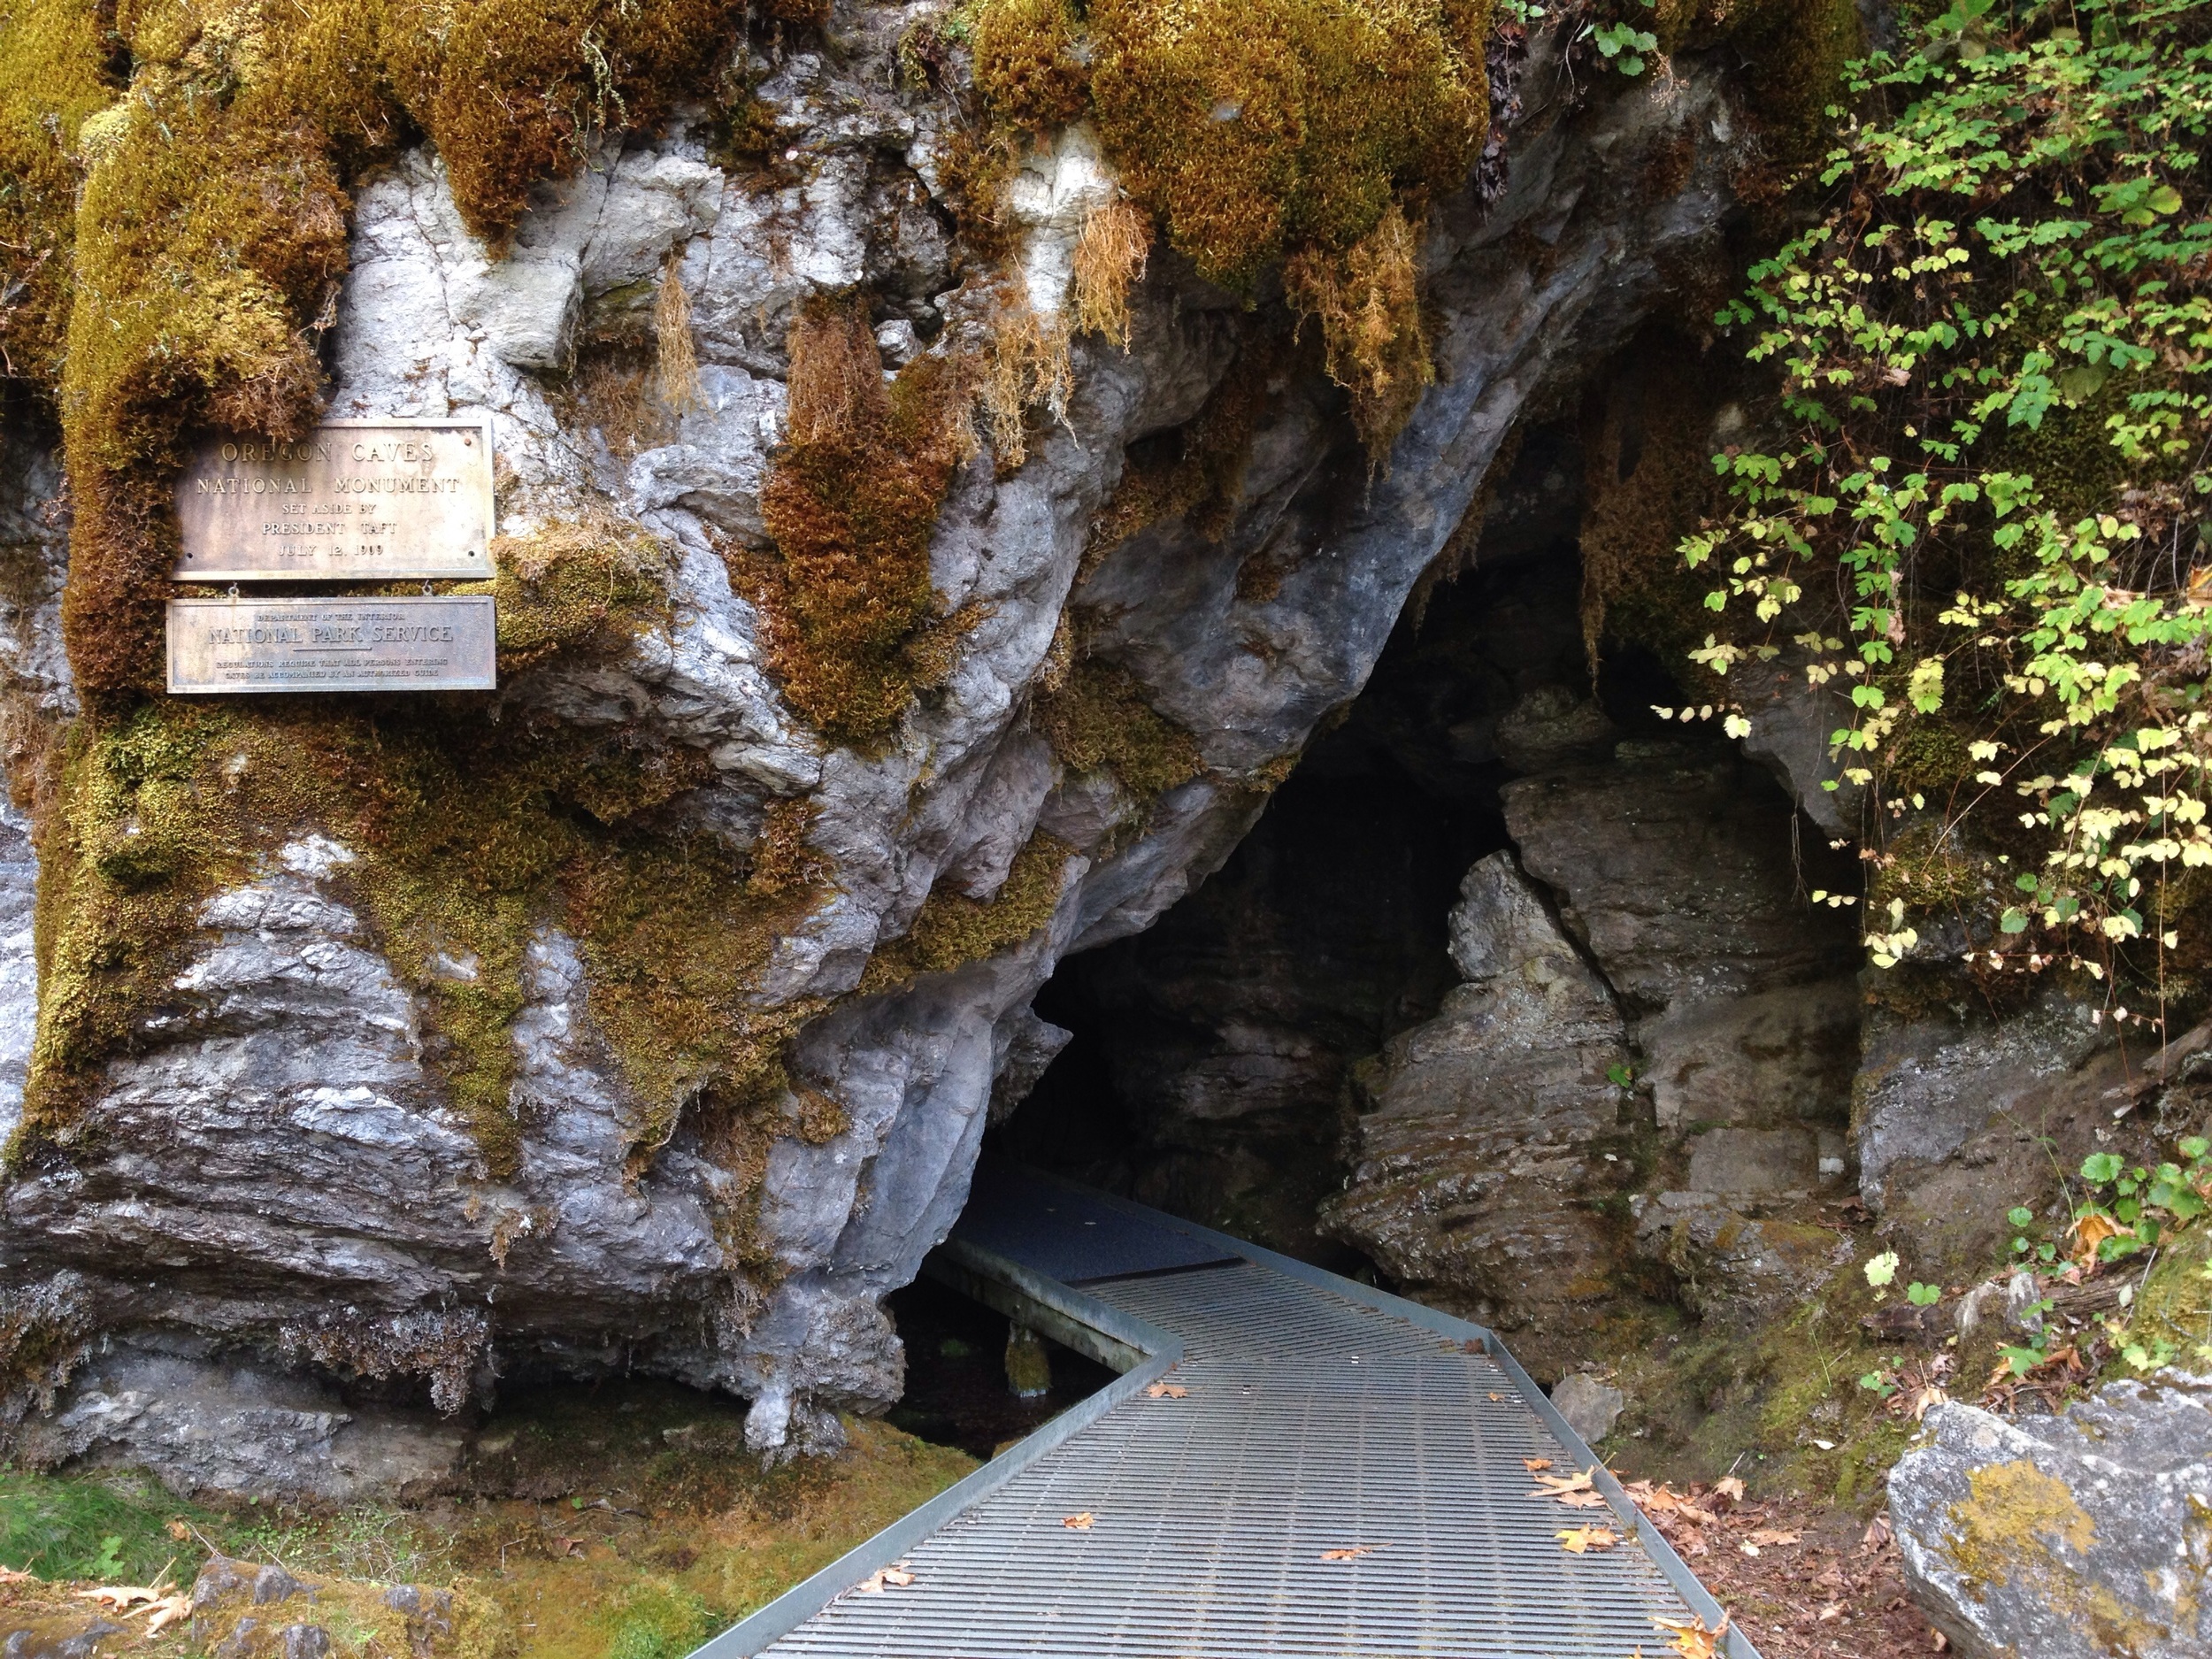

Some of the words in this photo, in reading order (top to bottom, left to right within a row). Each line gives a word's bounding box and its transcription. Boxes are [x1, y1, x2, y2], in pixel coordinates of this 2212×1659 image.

[221, 442, 332, 463] OREGON
[352, 442, 434, 462] CAVES
[196, 477, 312, 495] NATIONAL
[334, 477, 460, 494] MONUMENT
[282, 503, 306, 515] SET
[312, 503, 352, 515] ASIDE
[359, 503, 377, 515] BY
[262, 522, 345, 535] PRESIDENT
[361, 522, 398, 534] TAFT
[279, 545, 317, 557] JULY
[355, 545, 384, 556] 1909
[209, 627, 303, 644] NATIONAL
[311, 626, 365, 643] PARK
[372, 626, 453, 642] SERVICE
[216, 660, 274, 669] REGULATIONS
